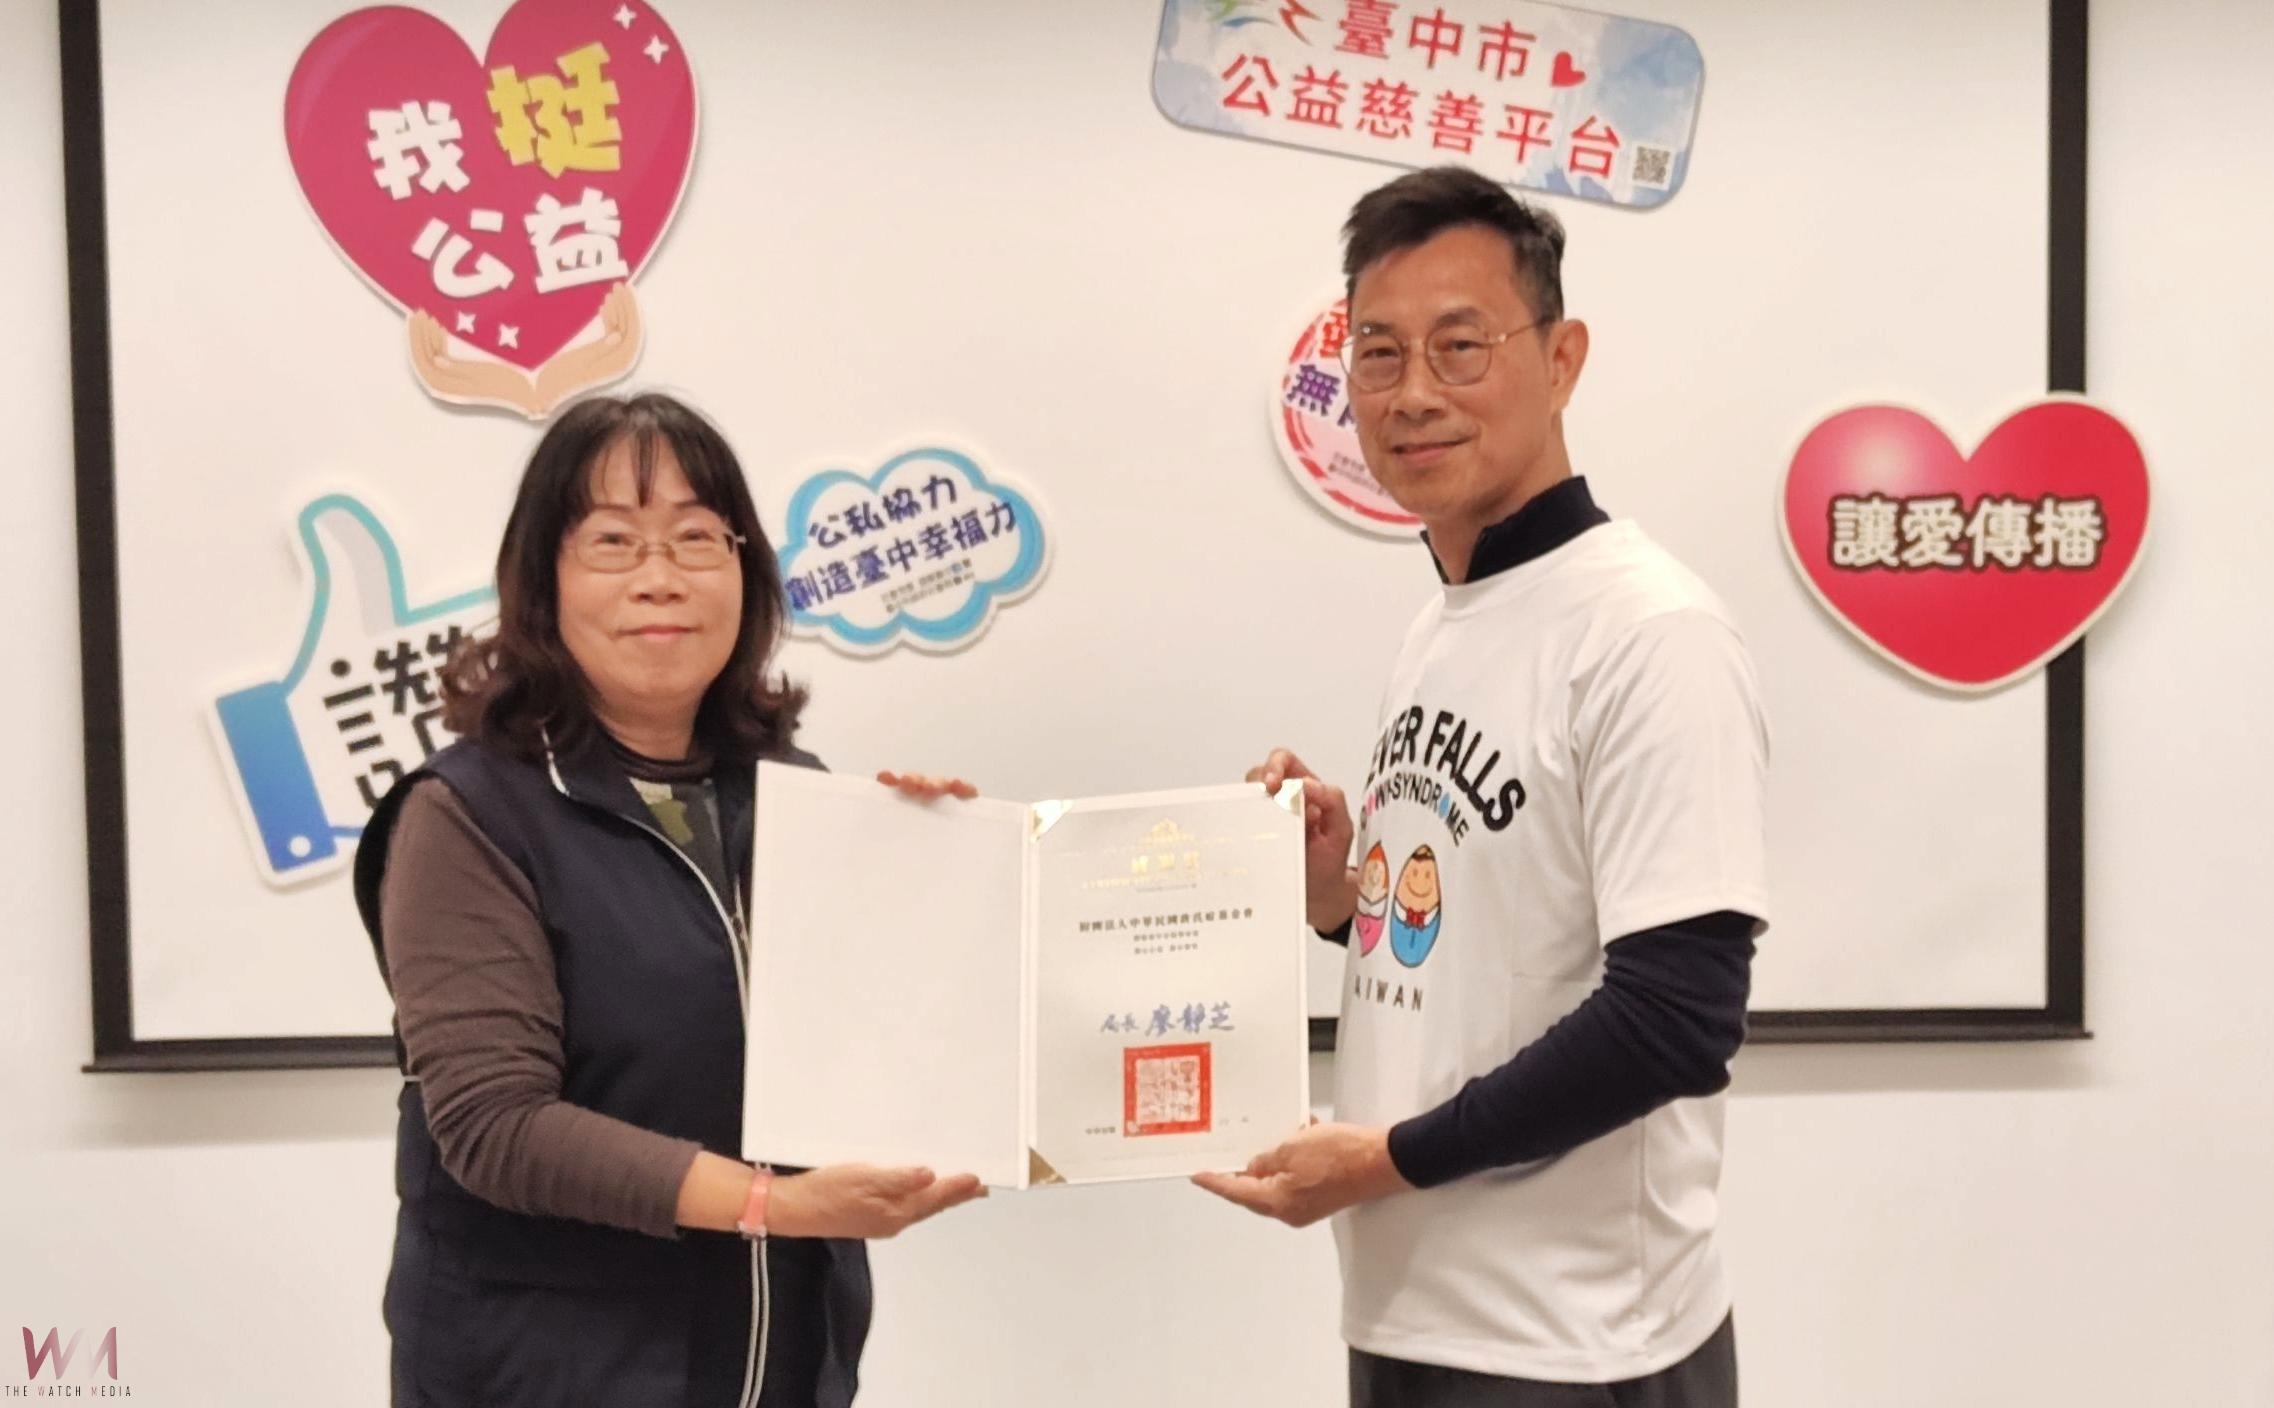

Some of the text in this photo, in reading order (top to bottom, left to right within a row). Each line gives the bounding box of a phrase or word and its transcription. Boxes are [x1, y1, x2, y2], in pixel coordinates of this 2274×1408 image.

[1336, 0, 1536, 81] 臺中市
[1220, 54, 1621, 179] 公益慈善平台
[411, 187, 629, 298] 公益
[1287, 364, 1356, 427] 無
[785, 501, 1016, 611] 創造臺中幸福力
[808, 474, 957, 548] 公私協力
[1830, 495, 2104, 569] 讓愛傳播
[1424, 711, 1526, 831] FALLS
